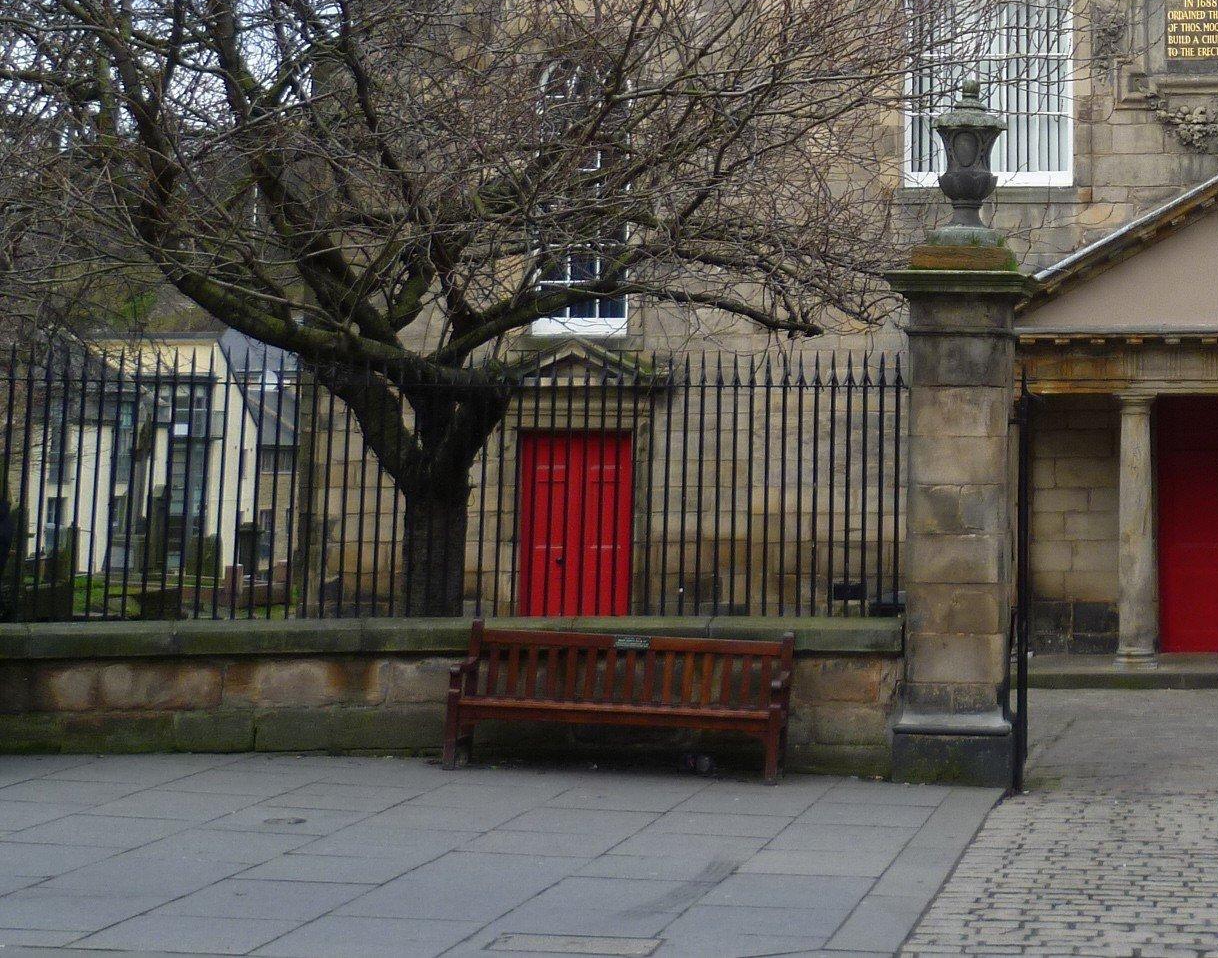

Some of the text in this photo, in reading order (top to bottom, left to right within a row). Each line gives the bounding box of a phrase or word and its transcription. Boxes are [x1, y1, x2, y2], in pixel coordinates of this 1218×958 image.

[1167, 10, 1206, 21] ORDAINED
[1167, 23, 1178, 33] OF
[1168, 35, 1191, 45] BUILD
[1192, 35, 1200, 44] A
[1167, 47, 1179, 57] TO
[1180, 47, 1195, 57] THE
